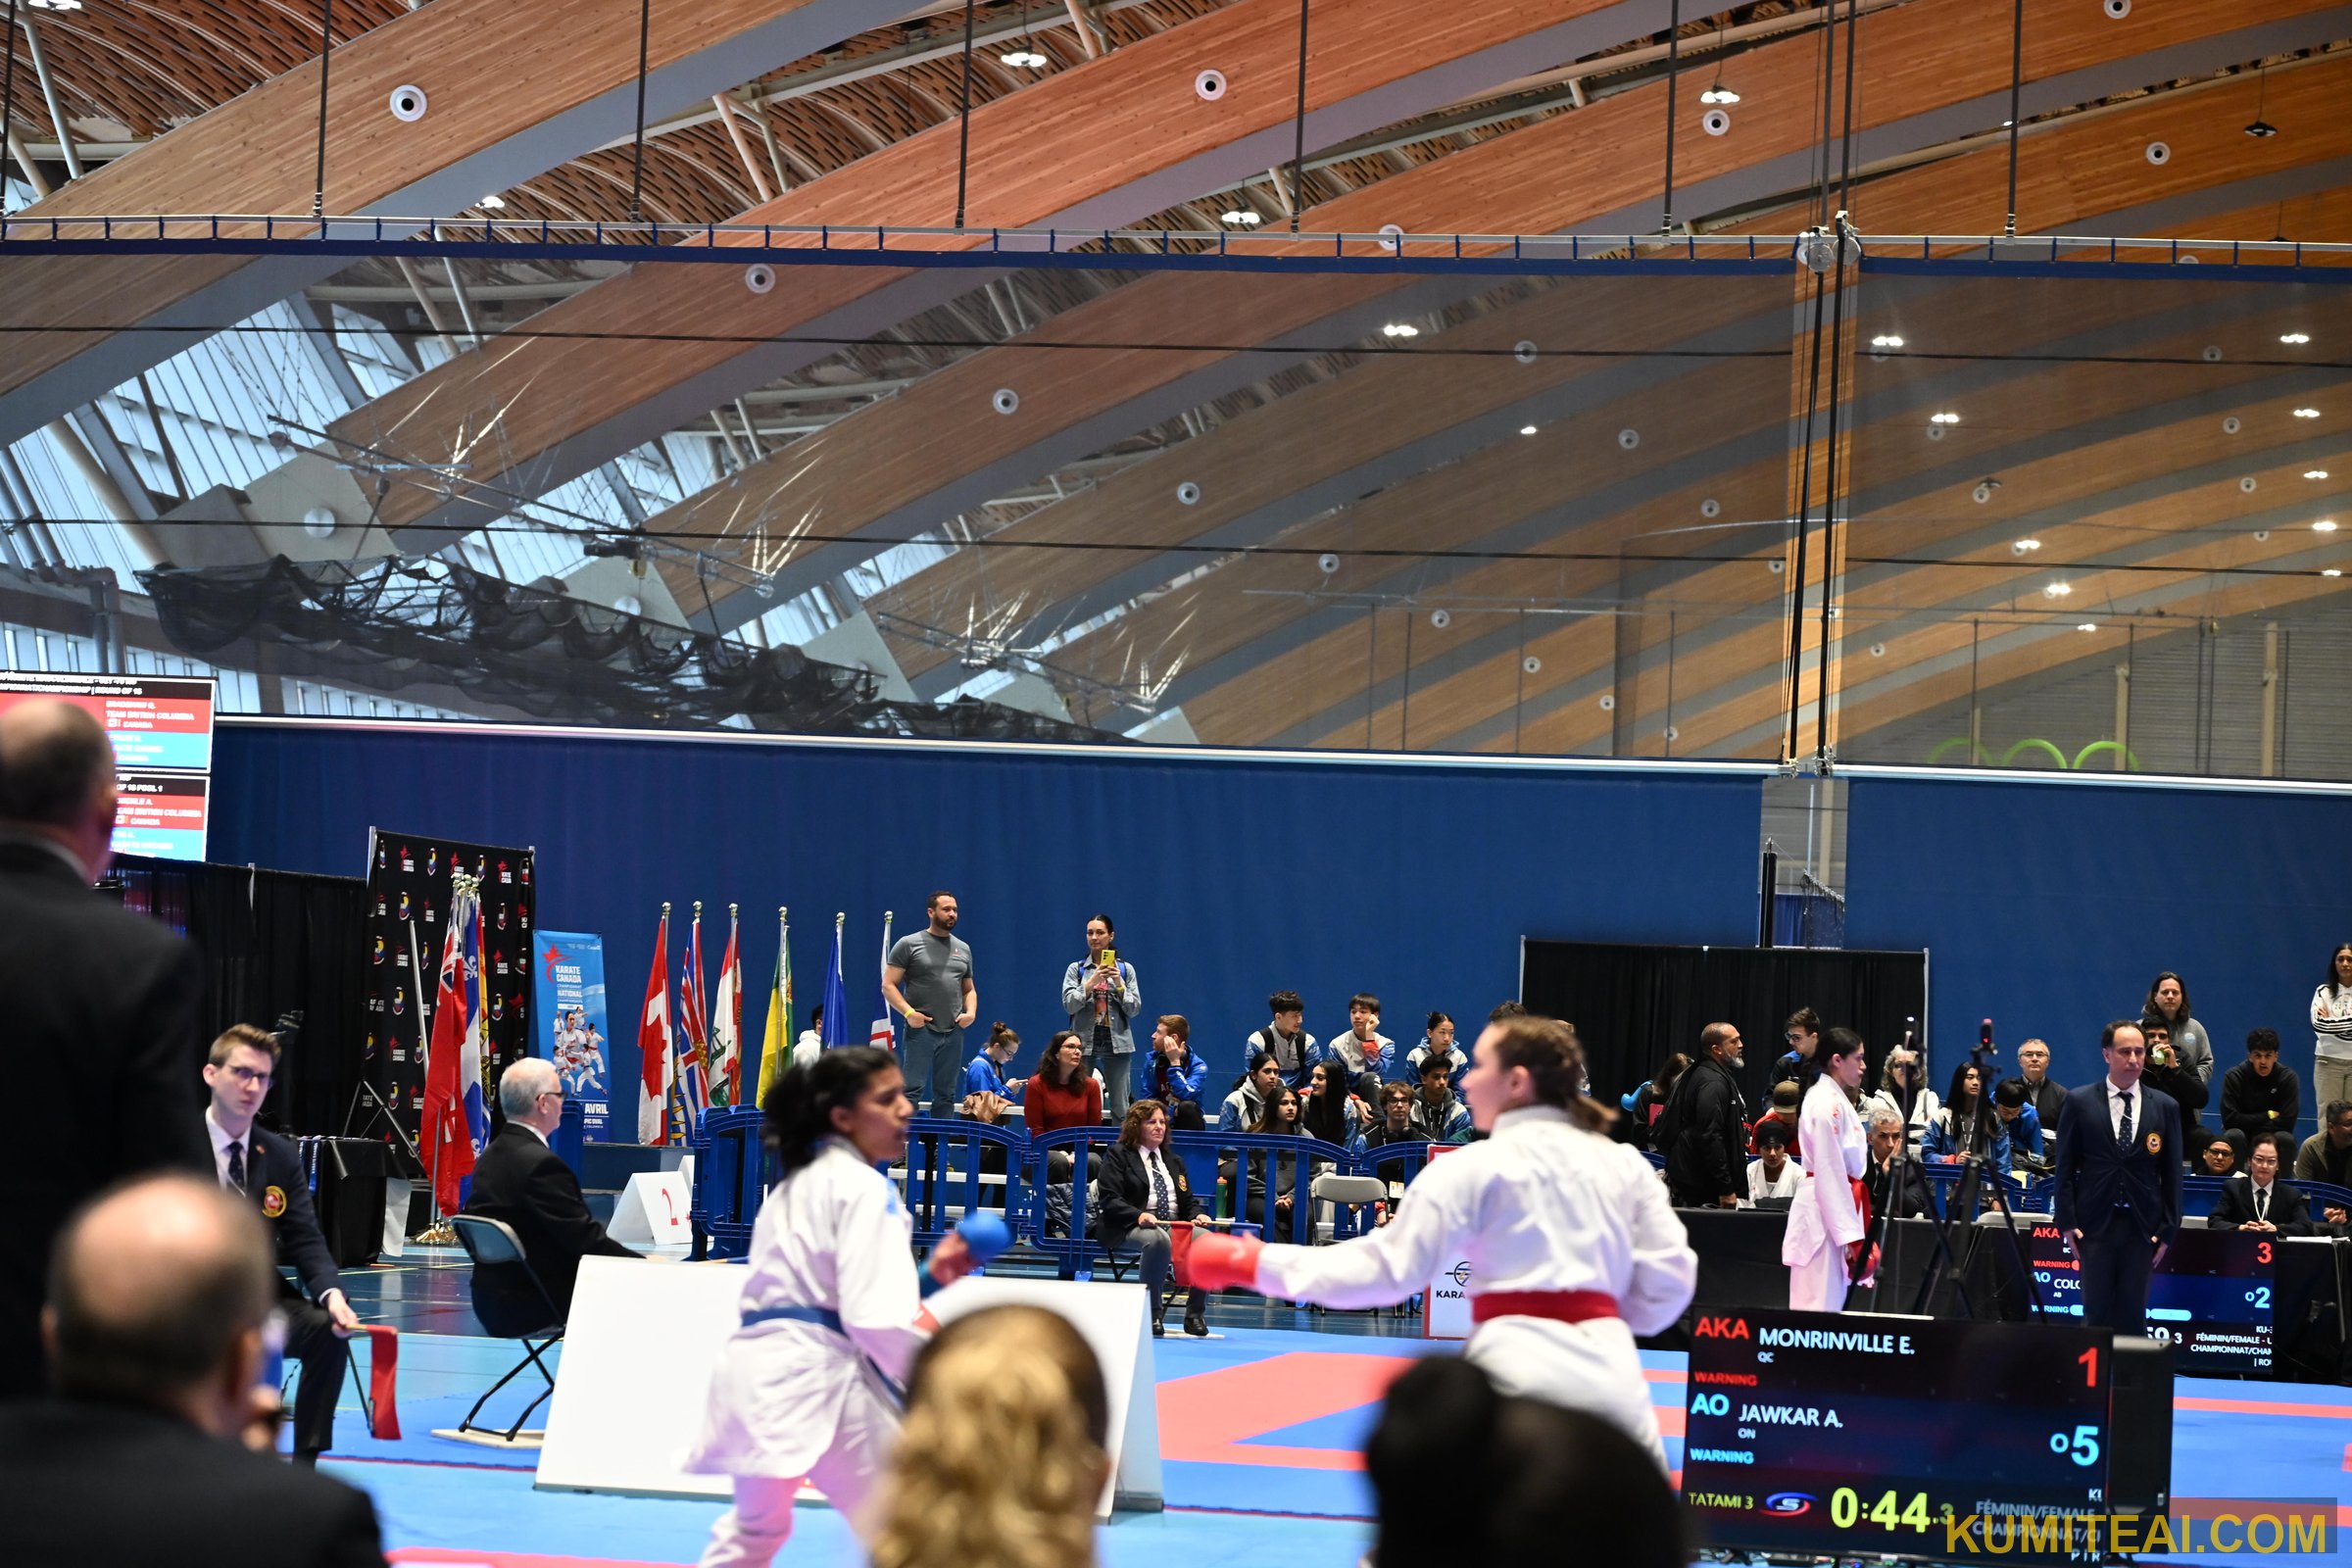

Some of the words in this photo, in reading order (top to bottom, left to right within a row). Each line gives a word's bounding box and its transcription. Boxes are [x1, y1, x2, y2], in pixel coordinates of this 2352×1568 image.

[556, 965, 580, 974] KARATE
[557, 974, 581, 983] CANADA
[585, 1103, 609, 1114] AVRIL
[2033, 1227, 2060, 1239] AKA
[2257, 1242, 2273, 1264] 3
[2034, 1260, 2070, 1269] WARNING
[2032, 1304, 2069, 1313] WRNING
[1694, 1316, 1750, 1340] AKA
[1759, 1327, 1894, 1354] MONRINVILLE
[1898, 1335, 1916, 1355] E.
[2196, 1332, 2260, 1344] FÉMININ/FEMALE
[1757, 1351, 1775, 1363] QC
[2079, 1347, 2098, 1388] 1
[1694, 1371, 1758, 1388] WARNING
[1690, 1393, 1731, 1417] AO
[1739, 1404, 1820, 1427] JAWKAR
[1824, 1409, 1844, 1429] A.
[1738, 1428, 1756, 1440] ON
[1690, 1448, 1755, 1465] WARNING
[1688, 1492, 1741, 1509] TATAMI
[1744, 1494, 1754, 1510] 3
